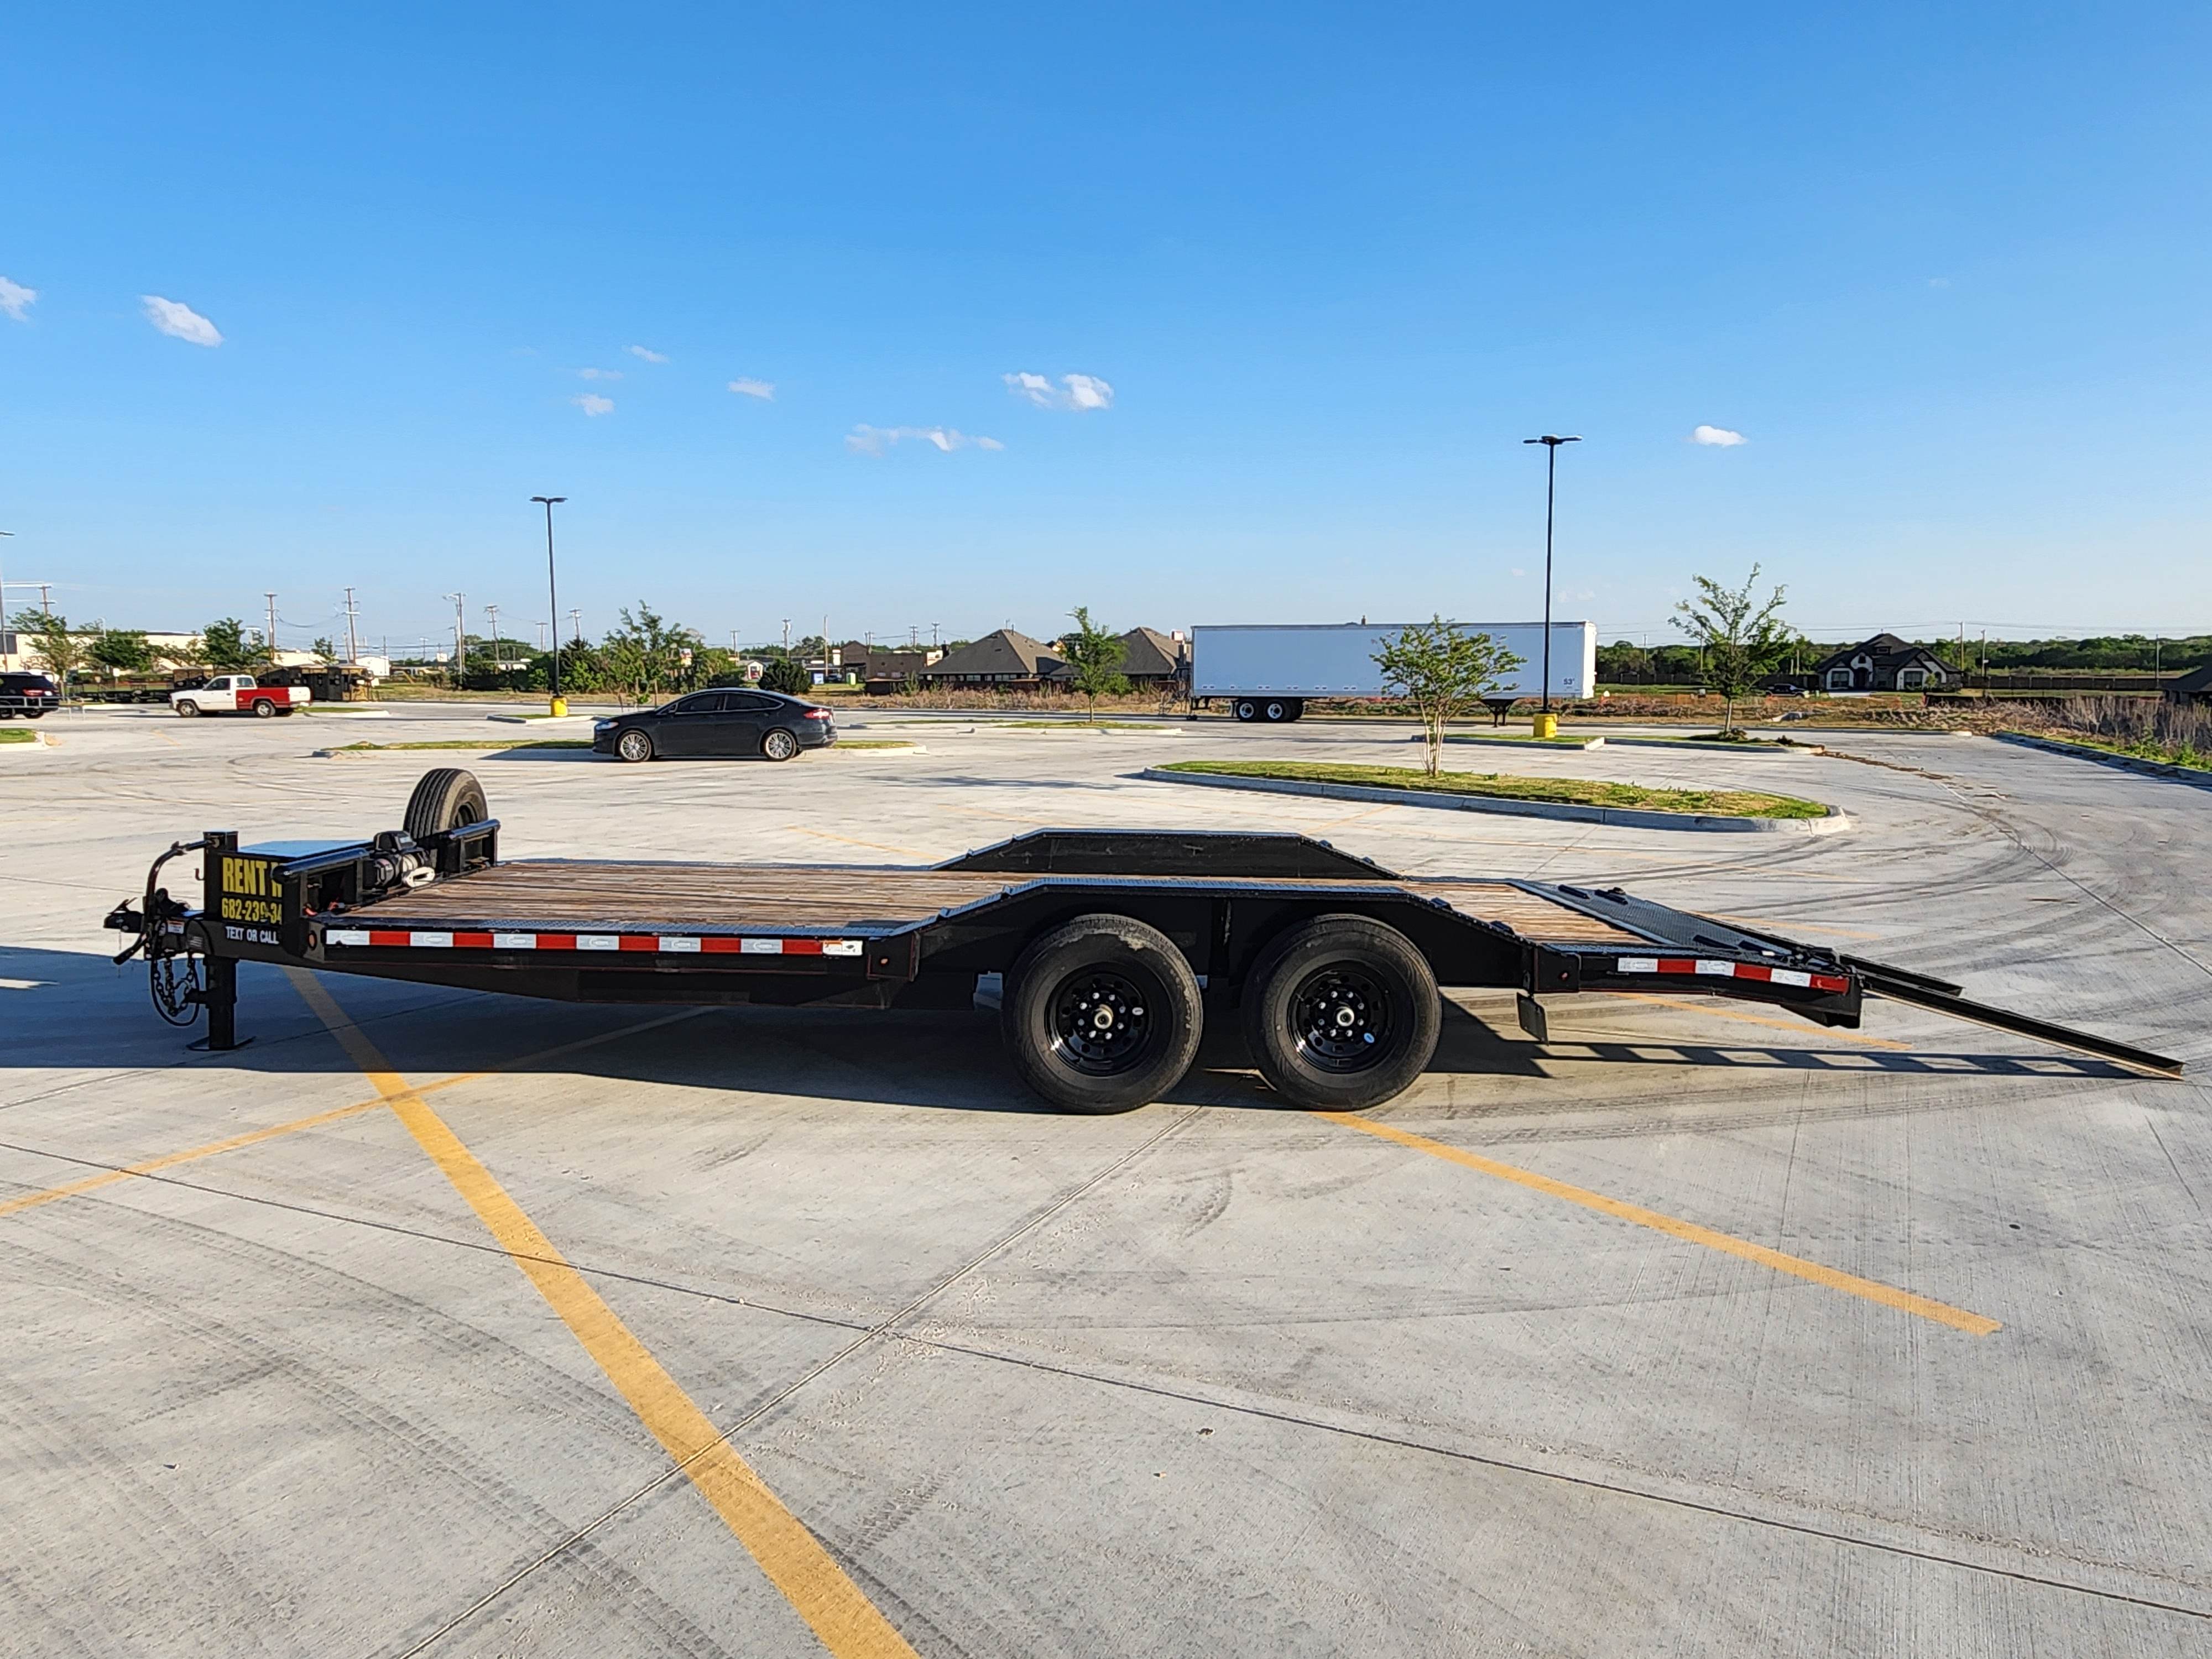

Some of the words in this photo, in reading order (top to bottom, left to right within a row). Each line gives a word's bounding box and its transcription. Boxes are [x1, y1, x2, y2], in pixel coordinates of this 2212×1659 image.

[222, 857, 267, 896] RENT
[225, 926, 244, 941] TEXT
[247, 928, 258, 942] OR
[260, 930, 279, 945] CALL
